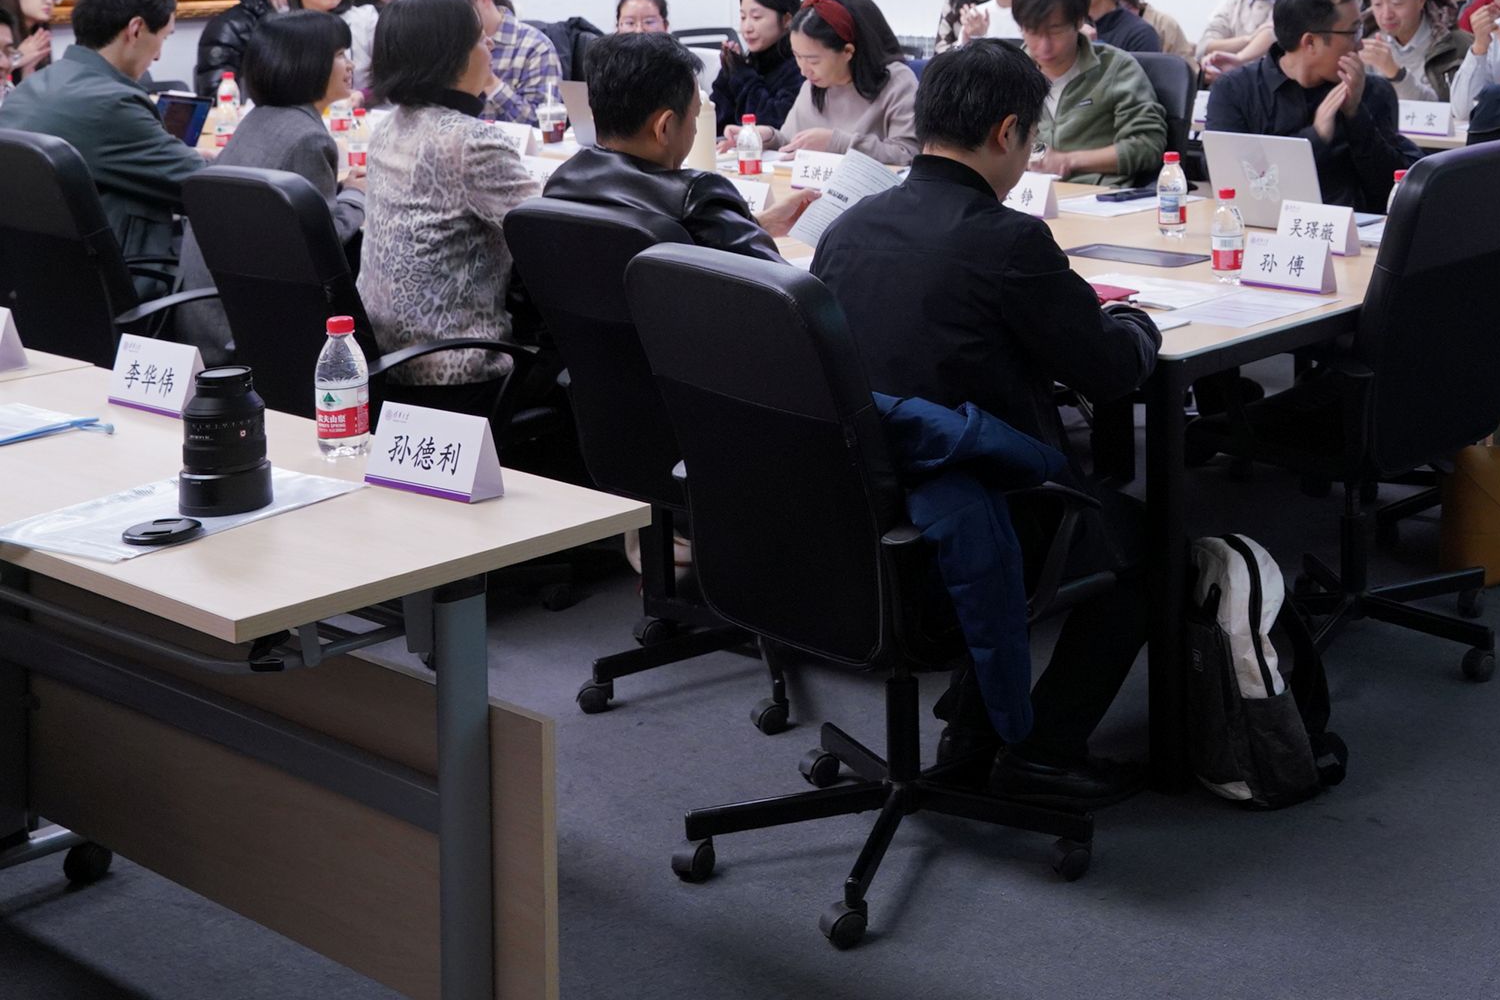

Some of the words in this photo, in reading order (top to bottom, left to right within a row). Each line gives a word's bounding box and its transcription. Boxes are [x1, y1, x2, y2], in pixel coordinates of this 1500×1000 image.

[124, 360, 175, 398] 李华伟
[387, 435, 462, 476] 孙德利
